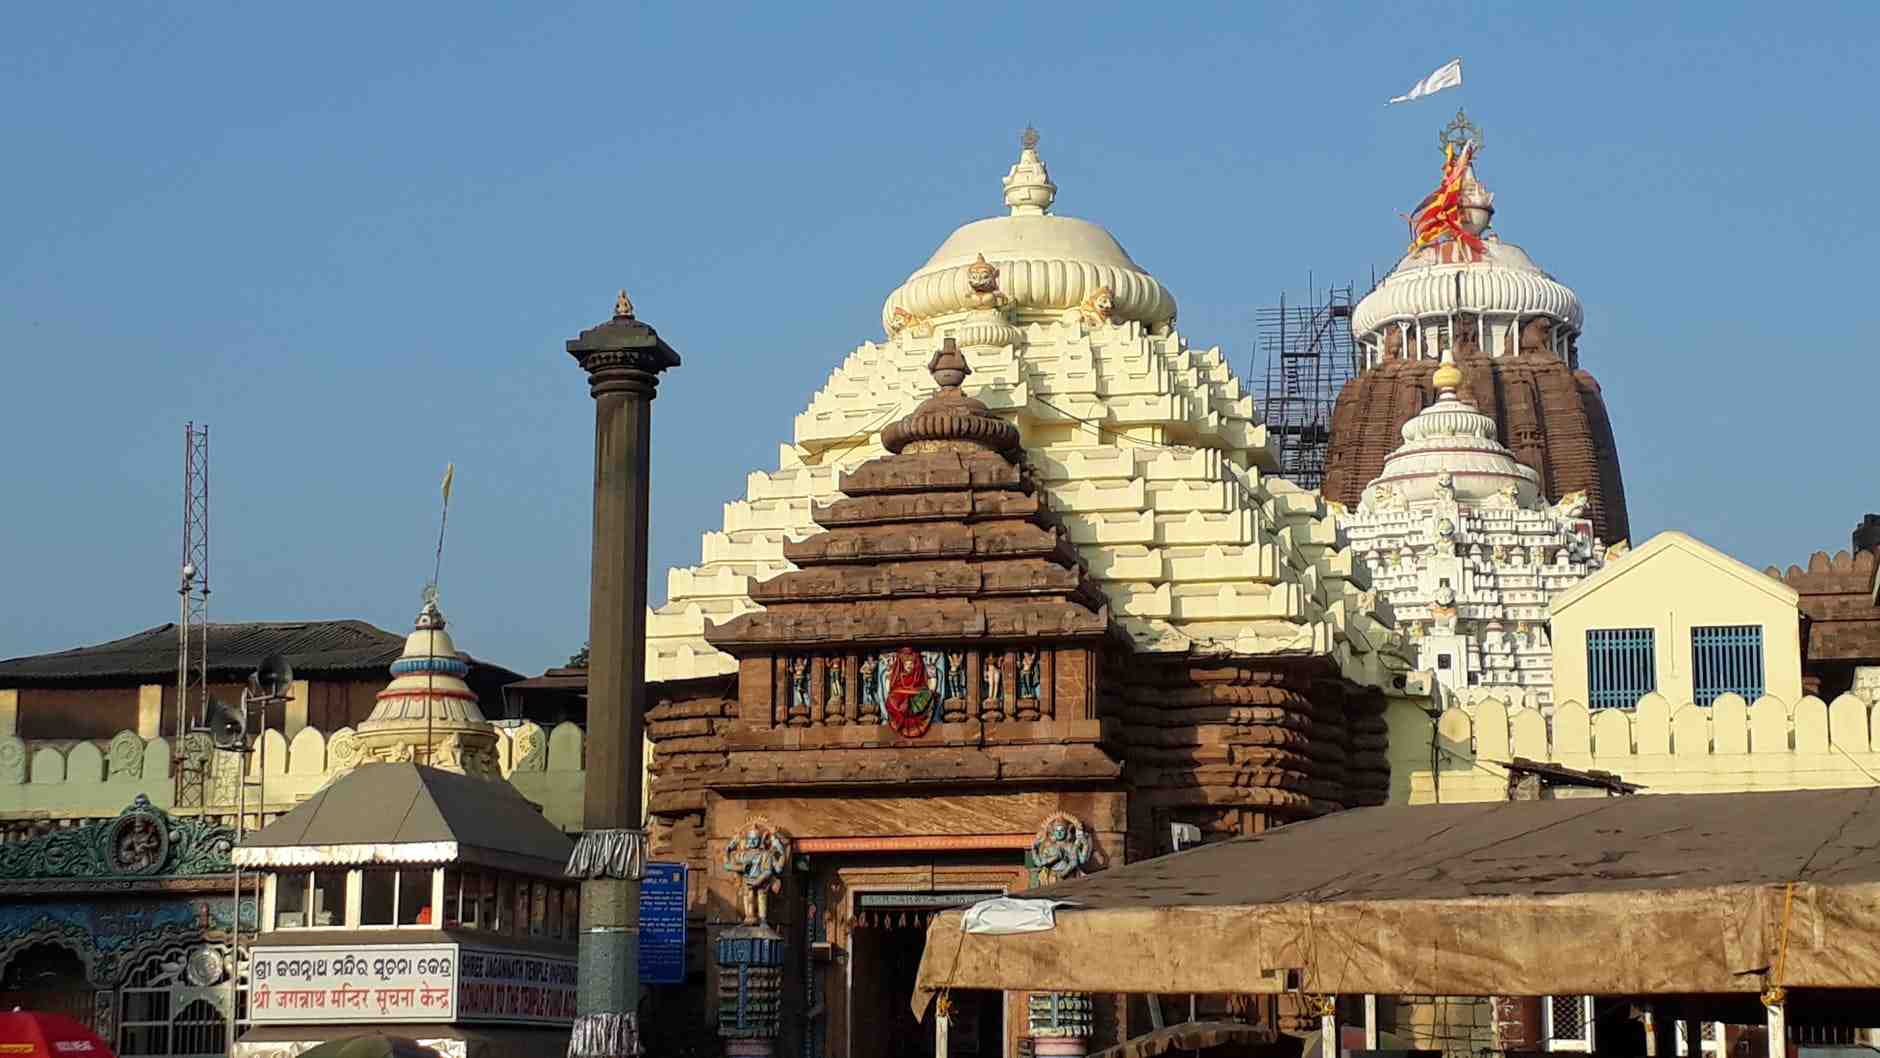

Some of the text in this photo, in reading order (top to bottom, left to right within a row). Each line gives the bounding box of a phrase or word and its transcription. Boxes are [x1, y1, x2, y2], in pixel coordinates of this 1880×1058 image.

[254, 954, 452, 982] ଶ୍ରୀ ଜଗନ୍ନାଥ ମନ୍ଦିର ସୂଚନା କେନ୍ଦ୍ର
[253, 981, 450, 1014] श्री जगन्नाथ मन्दिर सूचना केन्द्र
